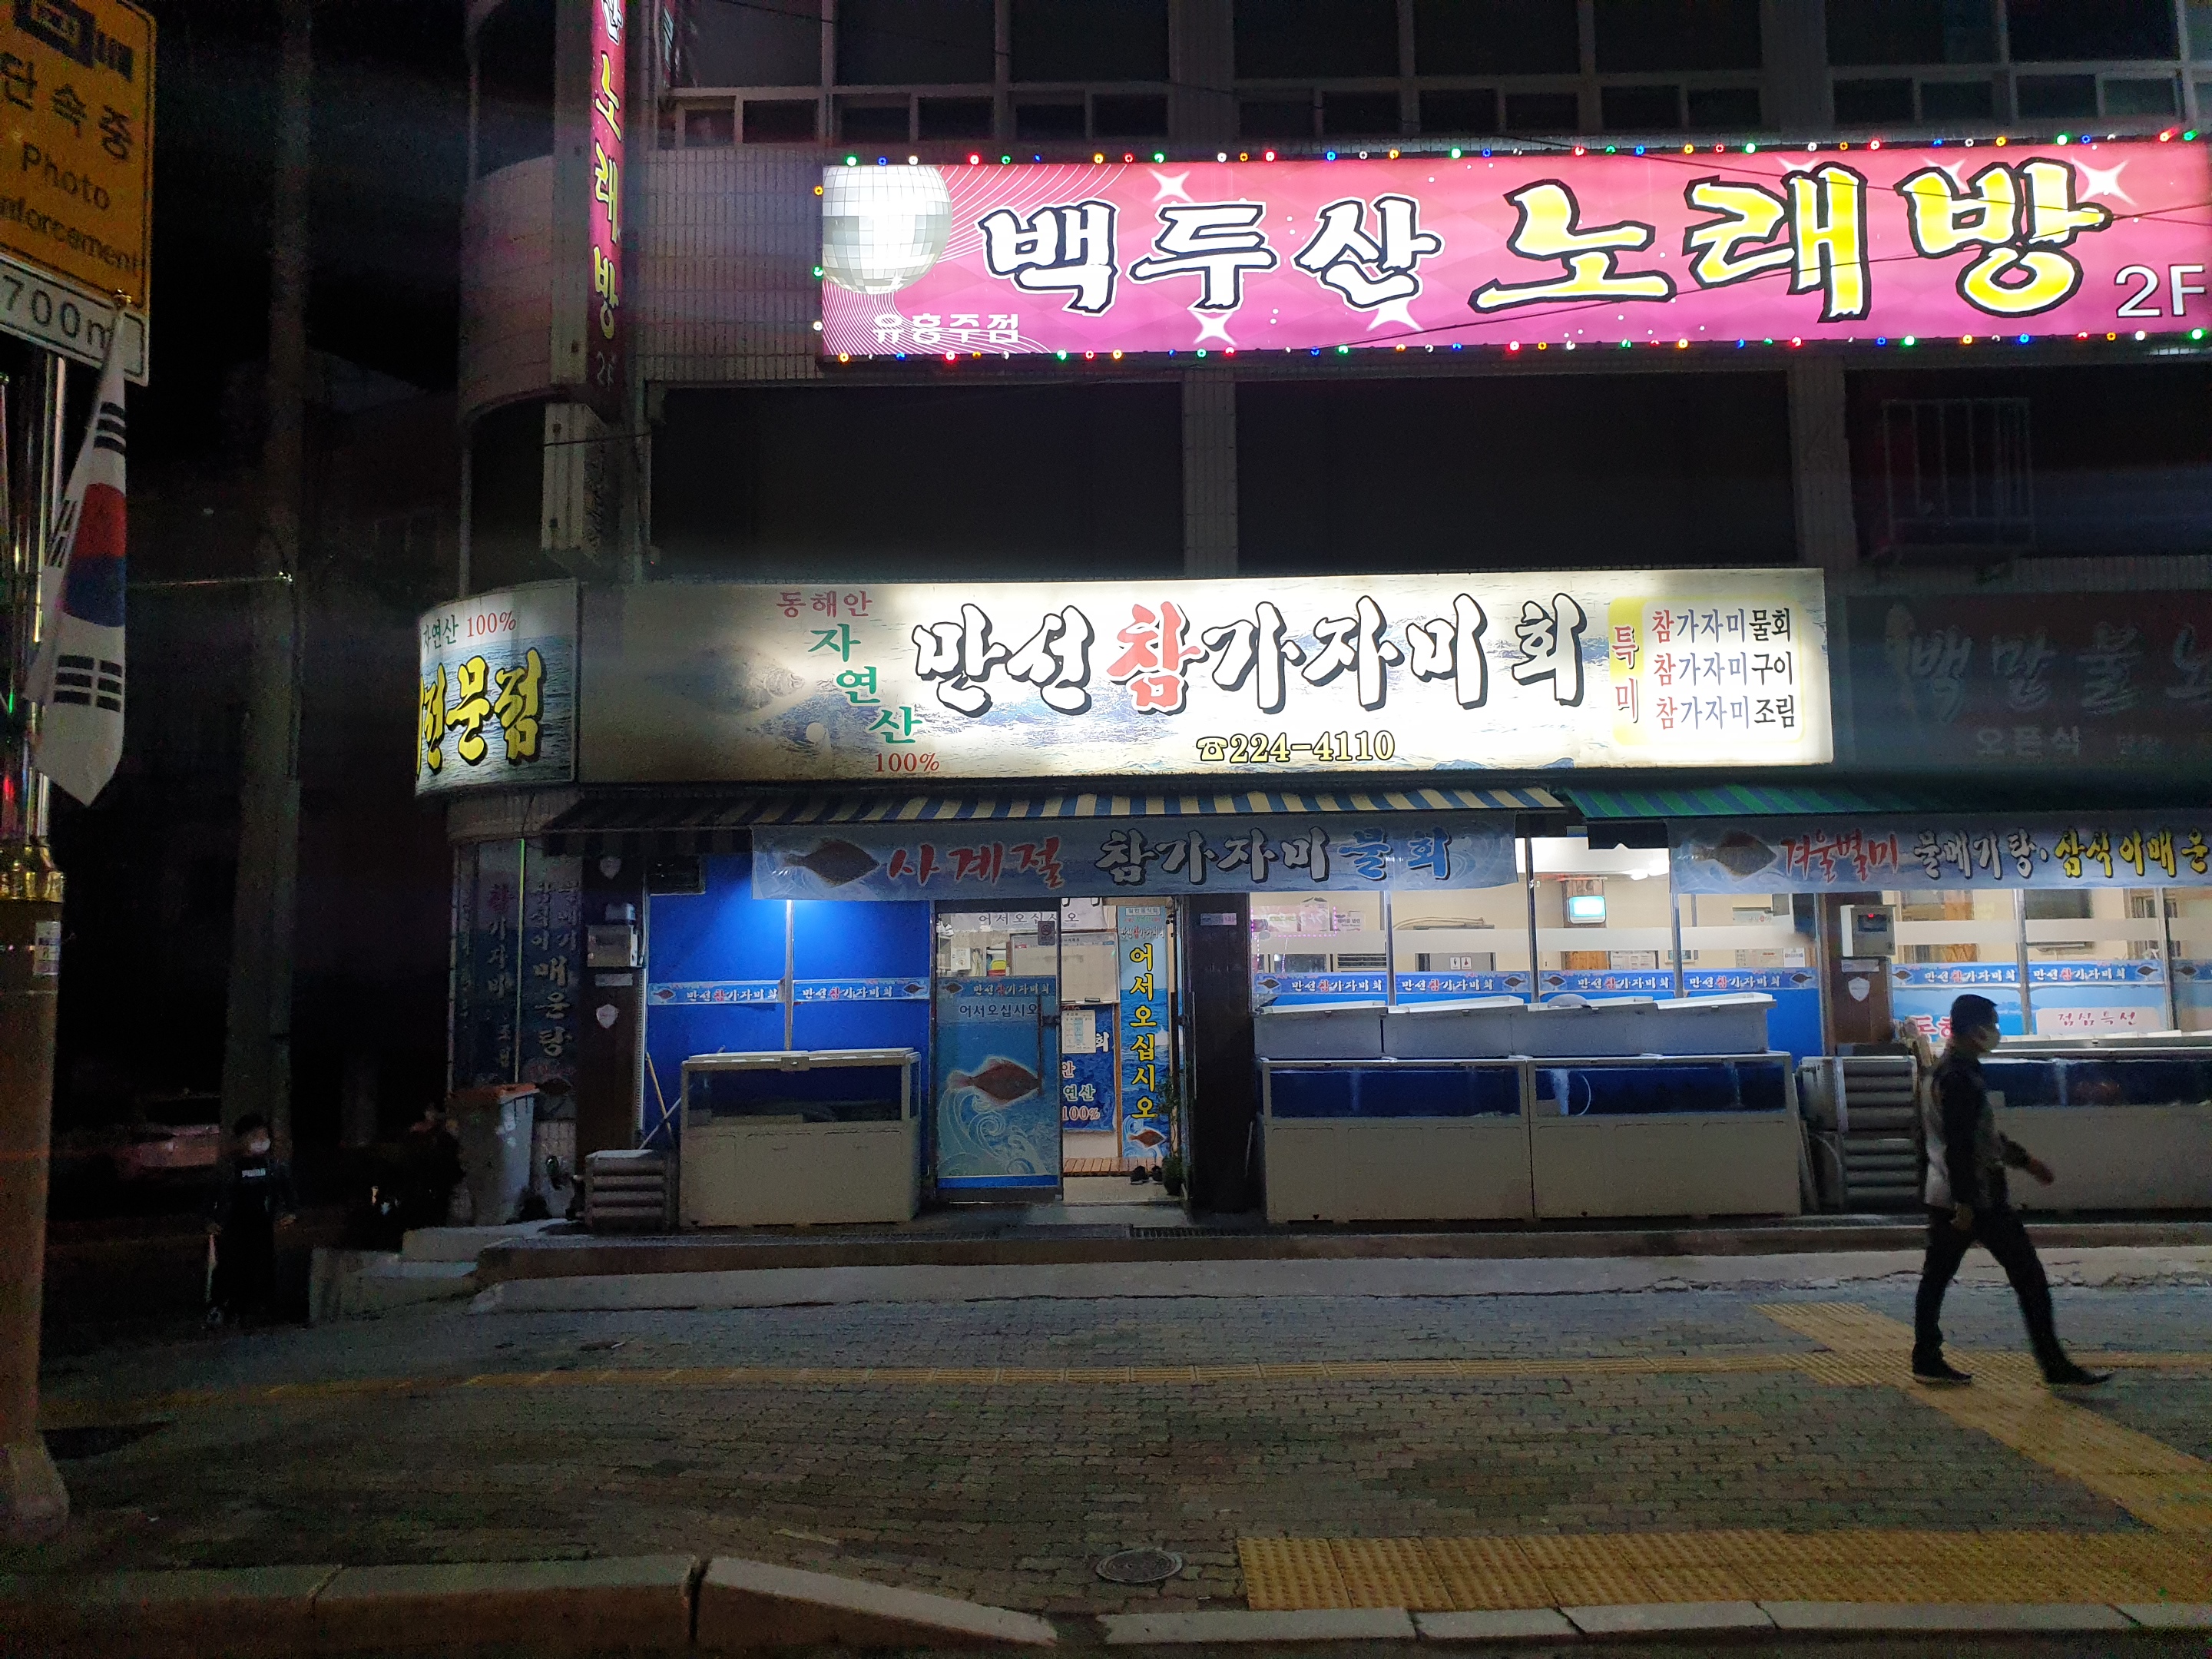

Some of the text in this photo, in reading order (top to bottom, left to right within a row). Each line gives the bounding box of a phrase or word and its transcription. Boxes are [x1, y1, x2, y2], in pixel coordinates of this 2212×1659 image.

[22, 141, 111, 211] Photo
[0, 195, 142, 274] nforcement
[979, 157, 2112, 323] 백두산 노래방
[2114, 264, 2208, 318] 2F
[873, 313, 1019, 345] 유흥주점
[423, 611, 517, 649] 자연산 100%
[776, 590, 873, 618] 동해안
[807, 623, 923, 745] 자연산
[874, 752, 941, 773] 100%
[887, 836, 1065, 890] 사계절
[1780, 827, 1899, 884] 겨울별미
[1062, 1105, 1101, 1121] 100%
